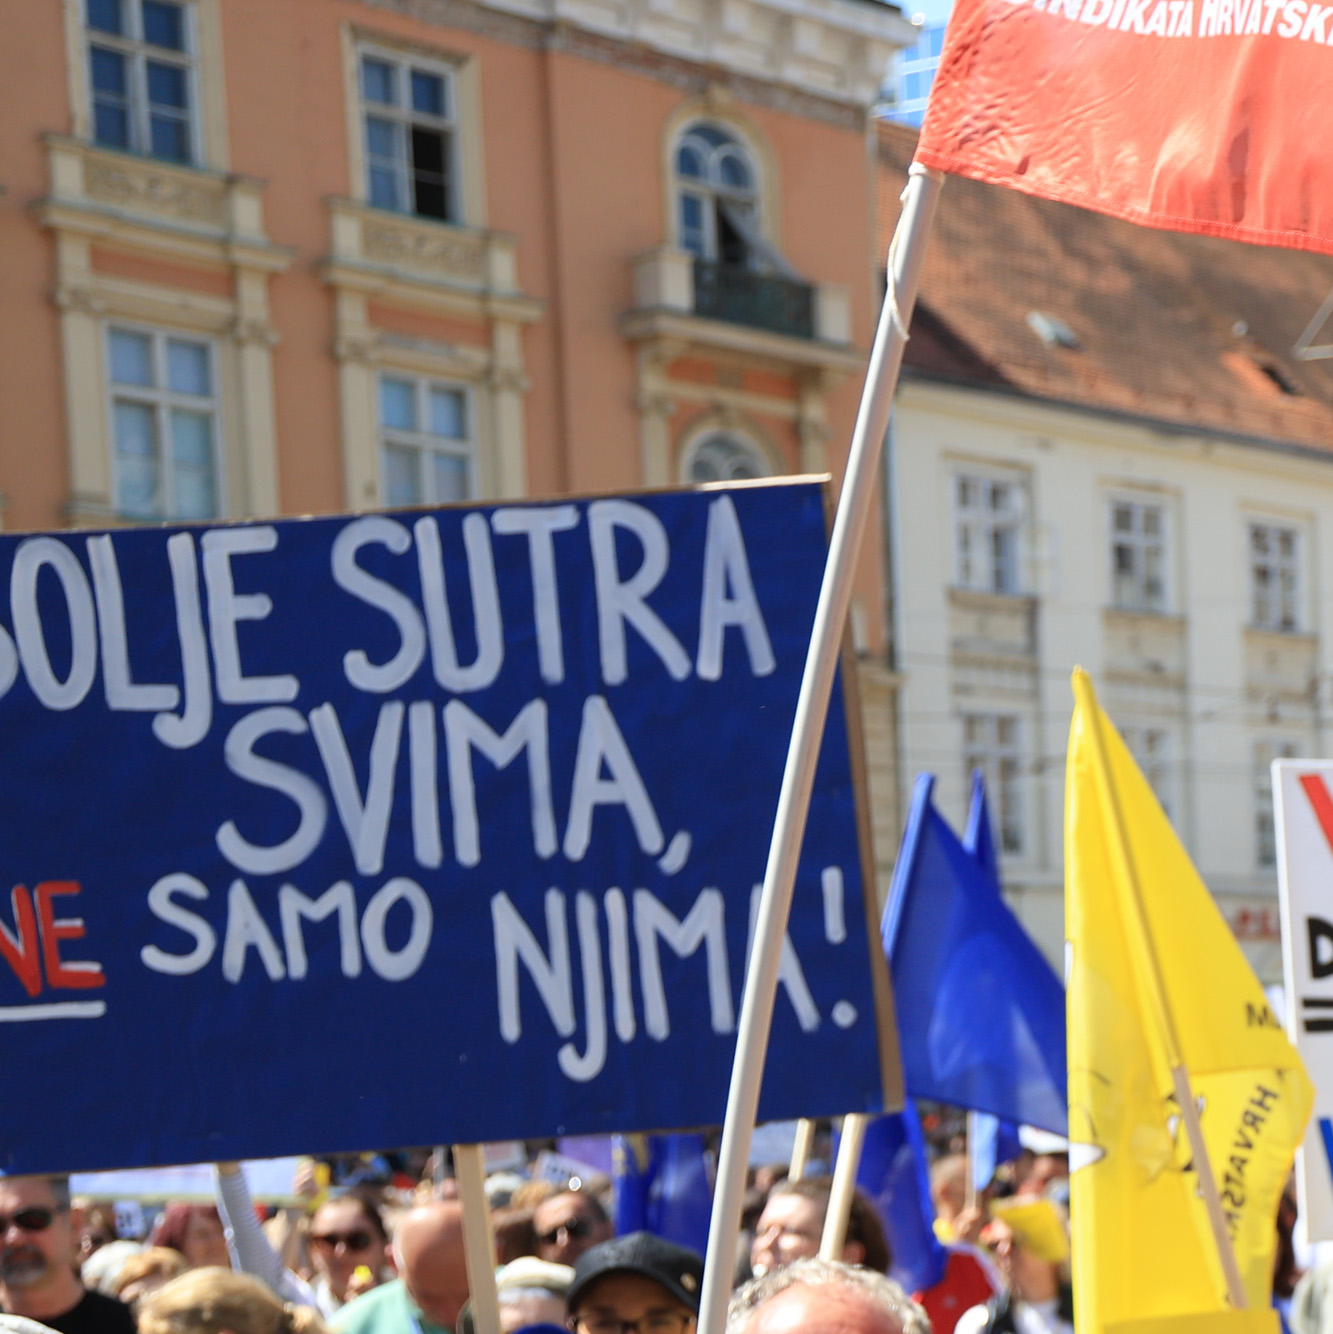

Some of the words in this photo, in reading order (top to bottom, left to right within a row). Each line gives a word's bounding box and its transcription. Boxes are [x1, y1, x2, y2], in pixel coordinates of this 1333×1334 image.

[0, 525, 300, 749] OLJE
[330, 494, 777, 694] SUTRA
[215, 694, 692, 876] SVIMA,
[141, 872, 434, 983] SAMO
